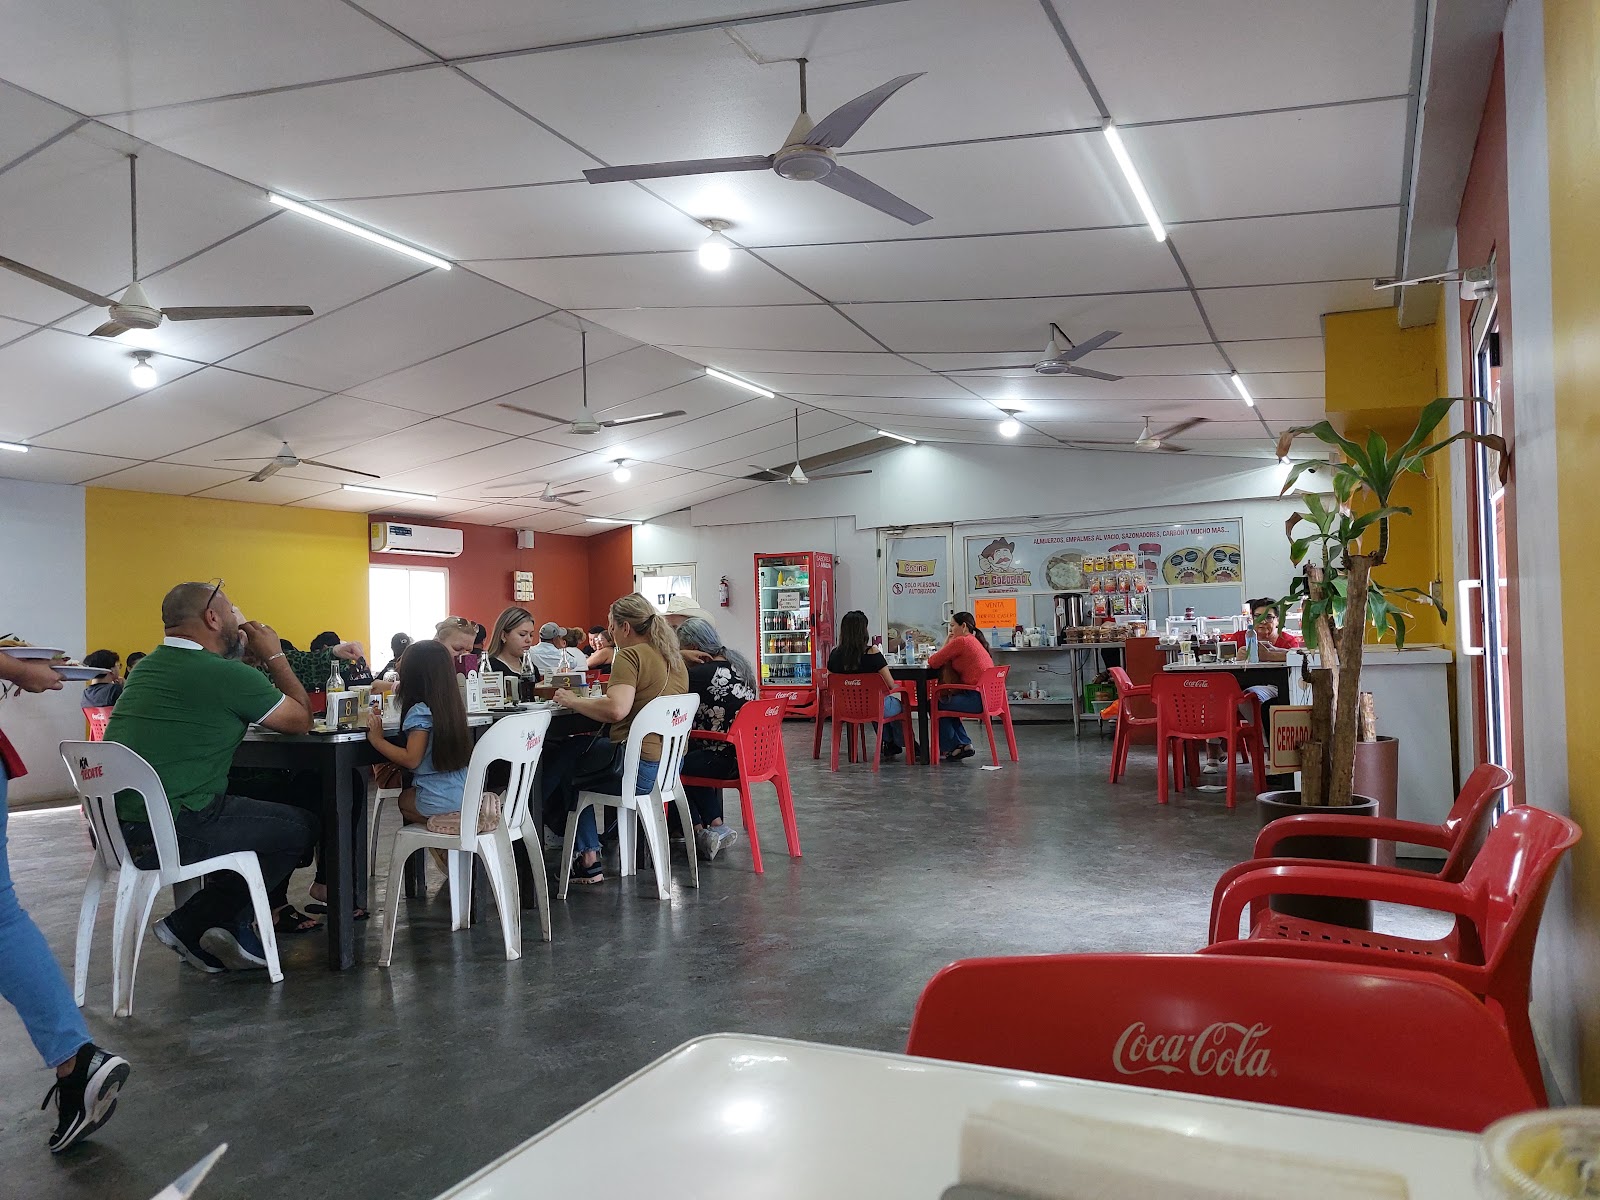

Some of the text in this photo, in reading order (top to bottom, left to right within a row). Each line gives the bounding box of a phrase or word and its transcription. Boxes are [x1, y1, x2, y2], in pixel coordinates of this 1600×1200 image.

[1066, 535, 1094, 543] EMPALMES
[1122, 531, 1161, 540] SAZONADORES,
[905, 562, 928, 573] Cocina
[979, 576, 989, 586] EL
[563, 677, 570, 688] 3
[1183, 679, 1209, 688] Coca-Cola
[345, 700, 352, 716] 8
[1112, 1021, 1273, 1077] Coca-Cola
